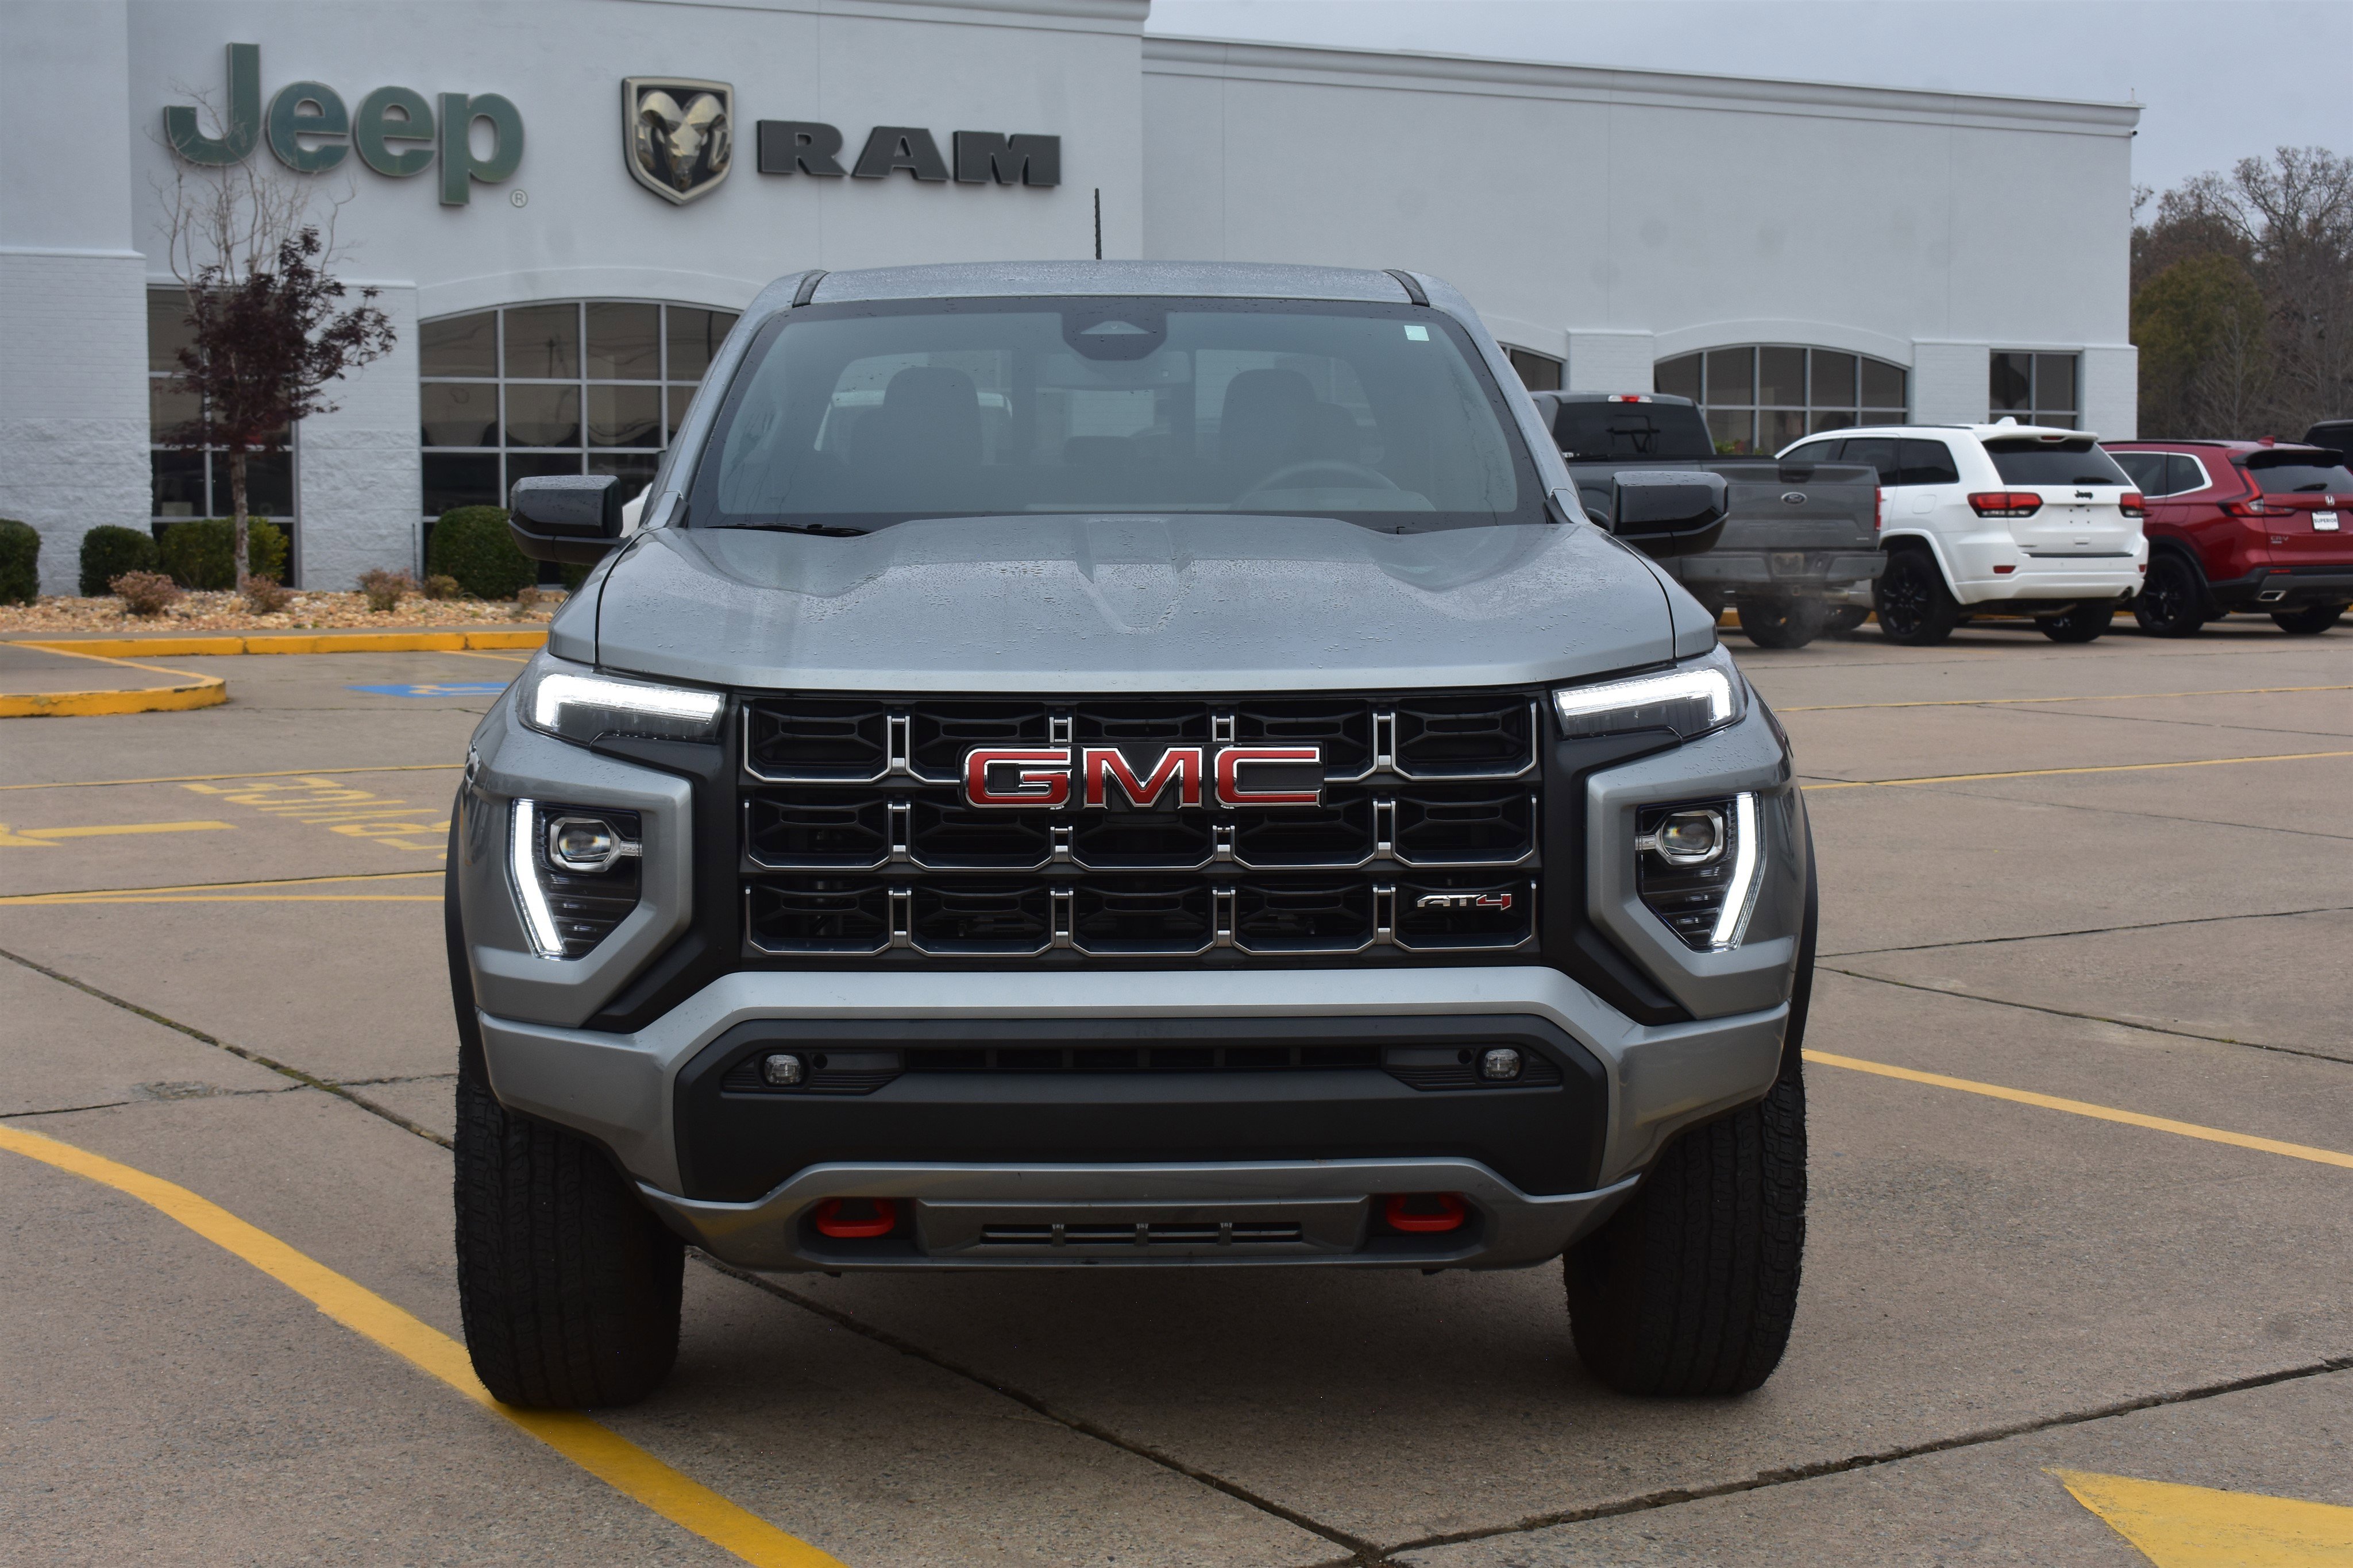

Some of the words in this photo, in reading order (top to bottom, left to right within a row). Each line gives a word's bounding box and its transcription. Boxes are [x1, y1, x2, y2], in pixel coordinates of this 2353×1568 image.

[164, 43, 524, 205] Jeep
[757, 119, 1062, 186] RAM
[964, 747, 1321, 808] GMC
[180, 777, 450, 860] RVICE
[1417, 894, 1511, 910] AT4
